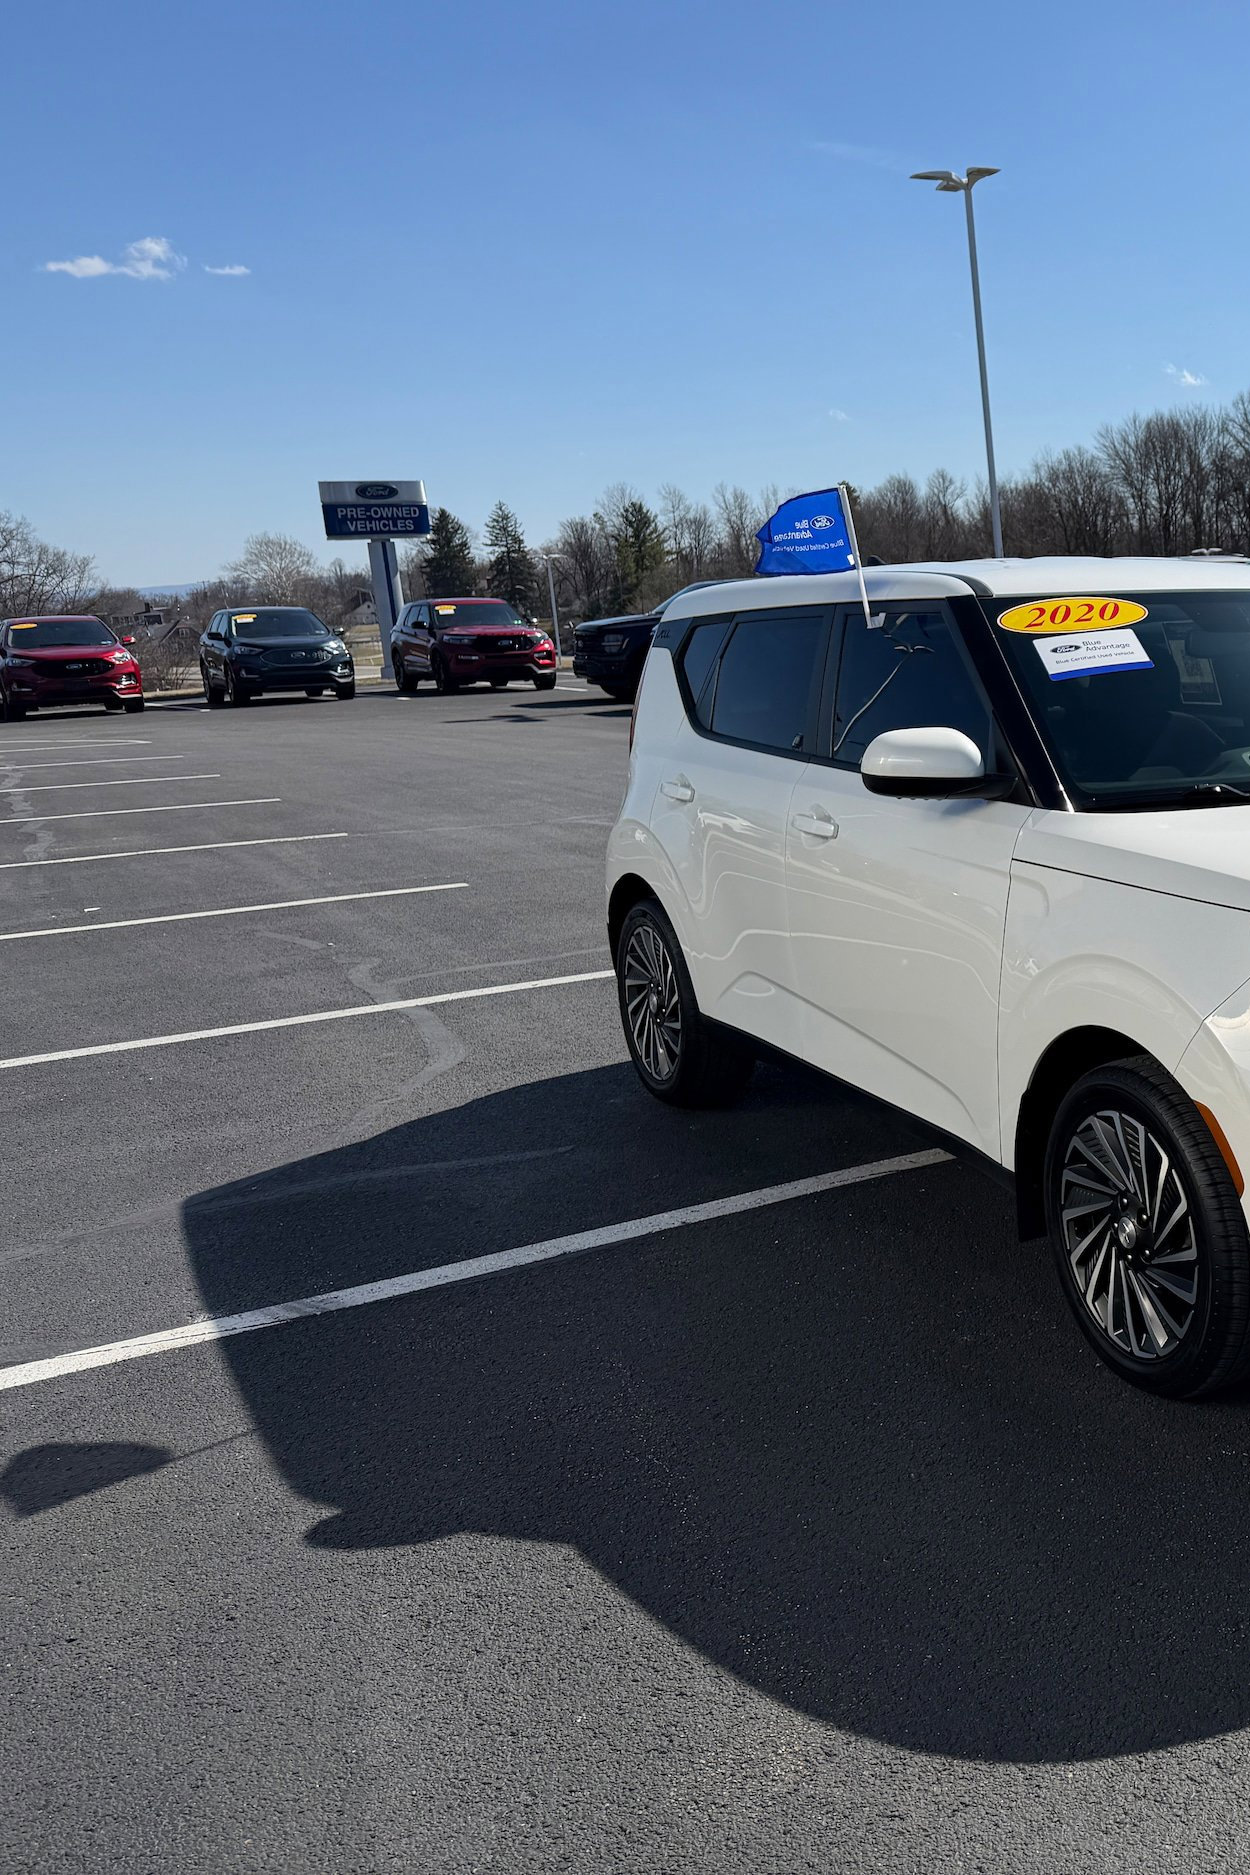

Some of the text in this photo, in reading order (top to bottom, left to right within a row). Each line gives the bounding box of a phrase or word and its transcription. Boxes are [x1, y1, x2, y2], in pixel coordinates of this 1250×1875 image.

[365, 487, 390, 496] Ford
[337, 507, 419, 519] PRE-OWNED
[347, 520, 414, 531] VEHICLES
[1024, 602, 1120, 629] 2020
[1086, 642, 1130, 652] Advantage
